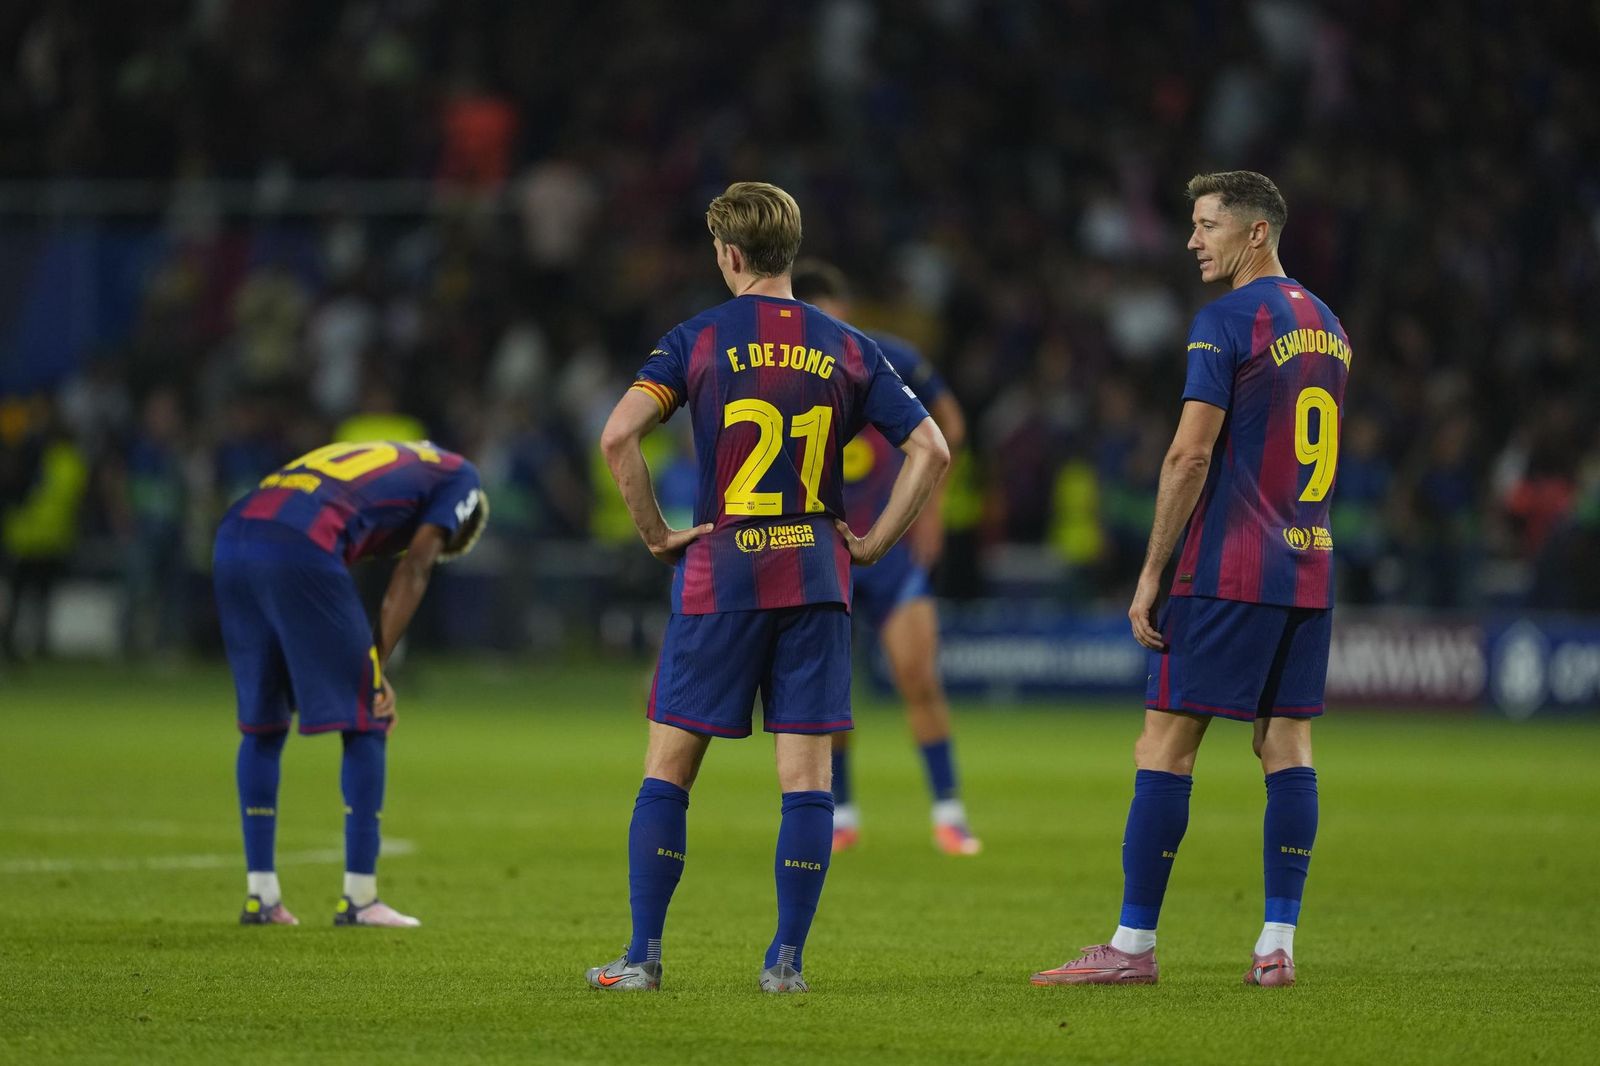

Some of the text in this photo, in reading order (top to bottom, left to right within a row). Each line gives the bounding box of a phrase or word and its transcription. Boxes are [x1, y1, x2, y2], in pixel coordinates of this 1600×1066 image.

[726, 343, 836, 380] F. DE JONG
[1294, 386, 1339, 502] 9
[723, 398, 833, 516] 21
[768, 524, 813, 537] UNHCR
[769, 533, 815, 546] ACNUR
[784, 858, 821, 871] BARÇA
